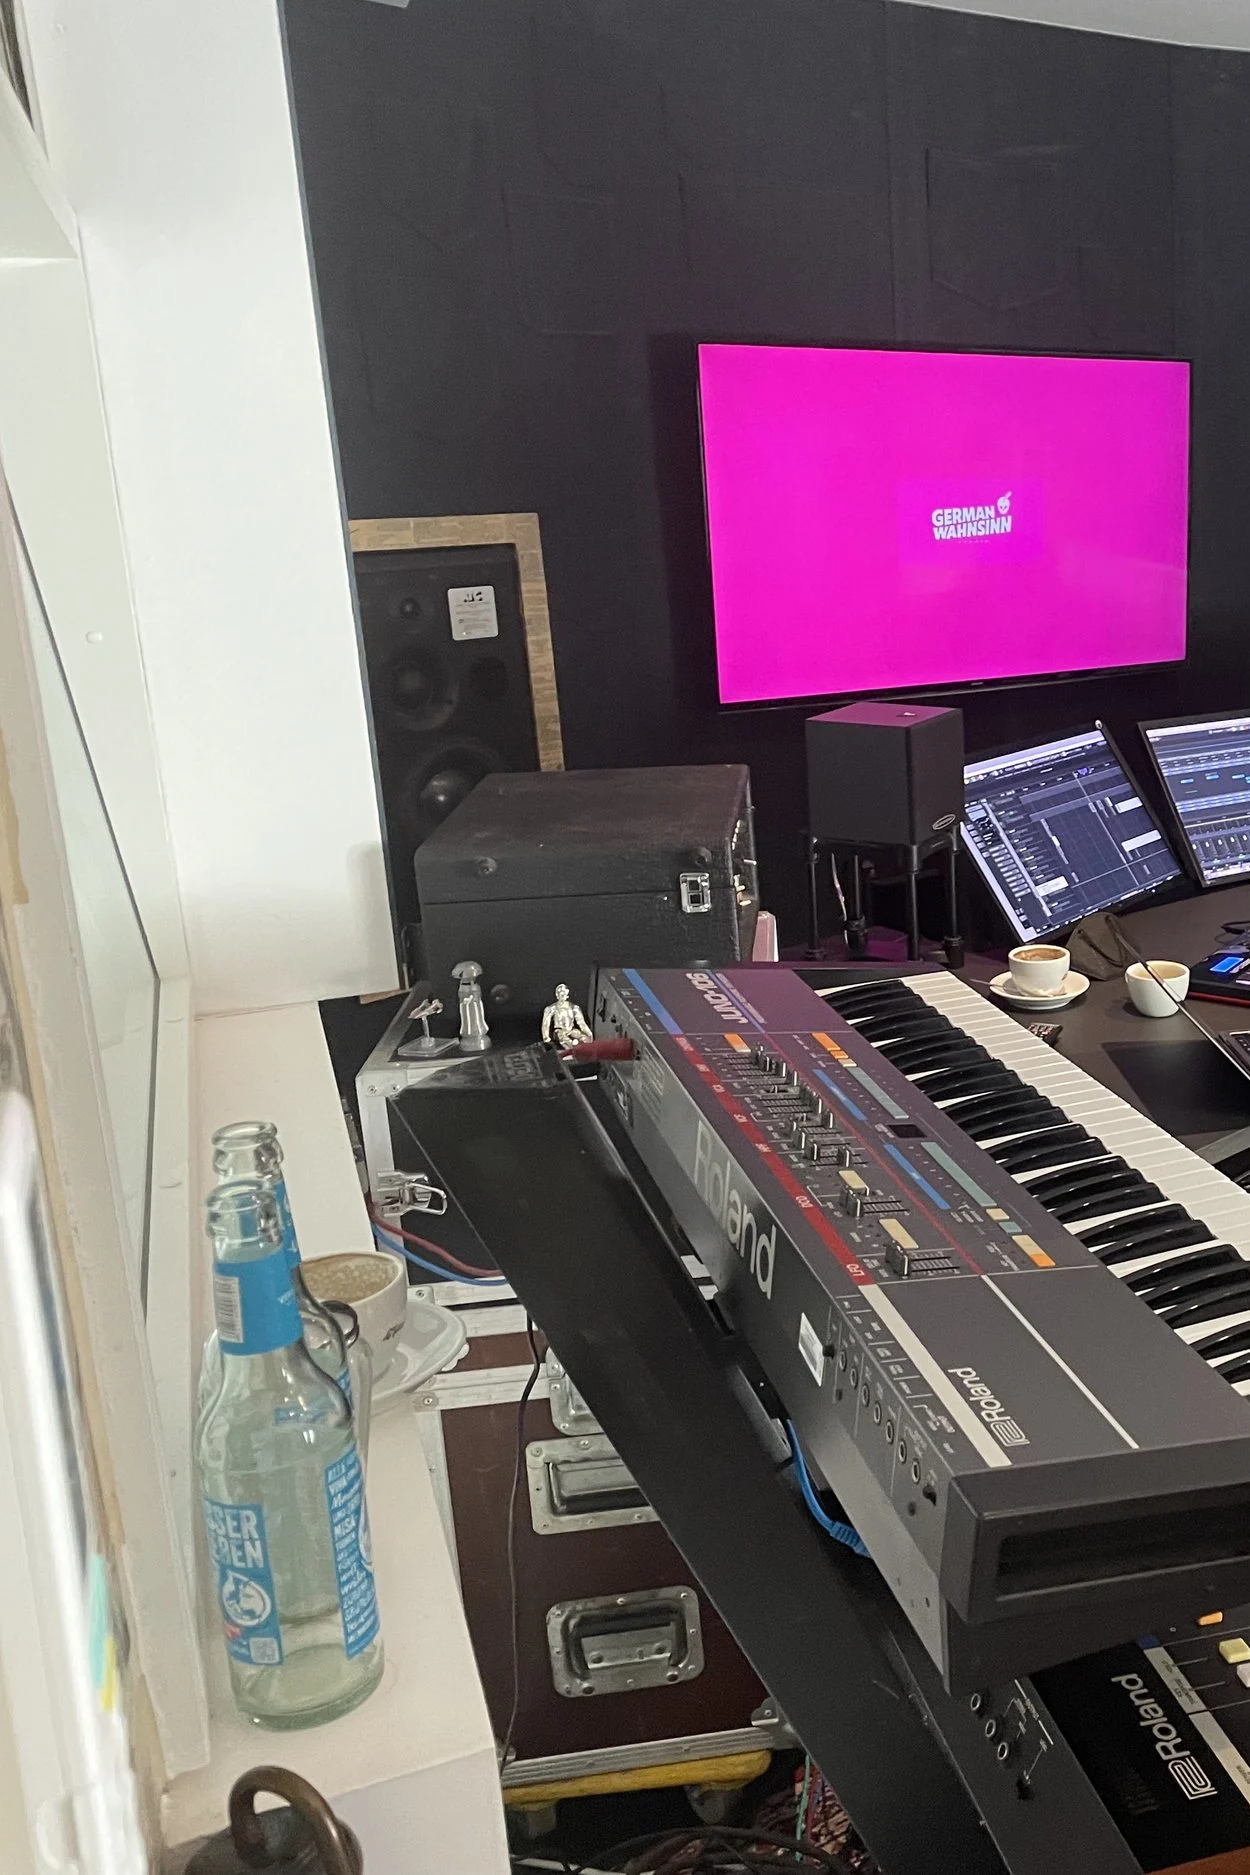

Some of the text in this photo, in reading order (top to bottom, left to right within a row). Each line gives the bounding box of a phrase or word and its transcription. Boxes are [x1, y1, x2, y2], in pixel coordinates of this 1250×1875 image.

[931, 505, 995, 527] GERMAN
[933, 515, 1012, 540] WAHNSINN
[686, 973, 749, 1024] JUNO-106
[694, 1120, 776, 1300] Roland
[796, 1195, 813, 1209] DCO
[846, 1263, 865, 1277] LFO
[1110, 1673, 1191, 1761] Roland
